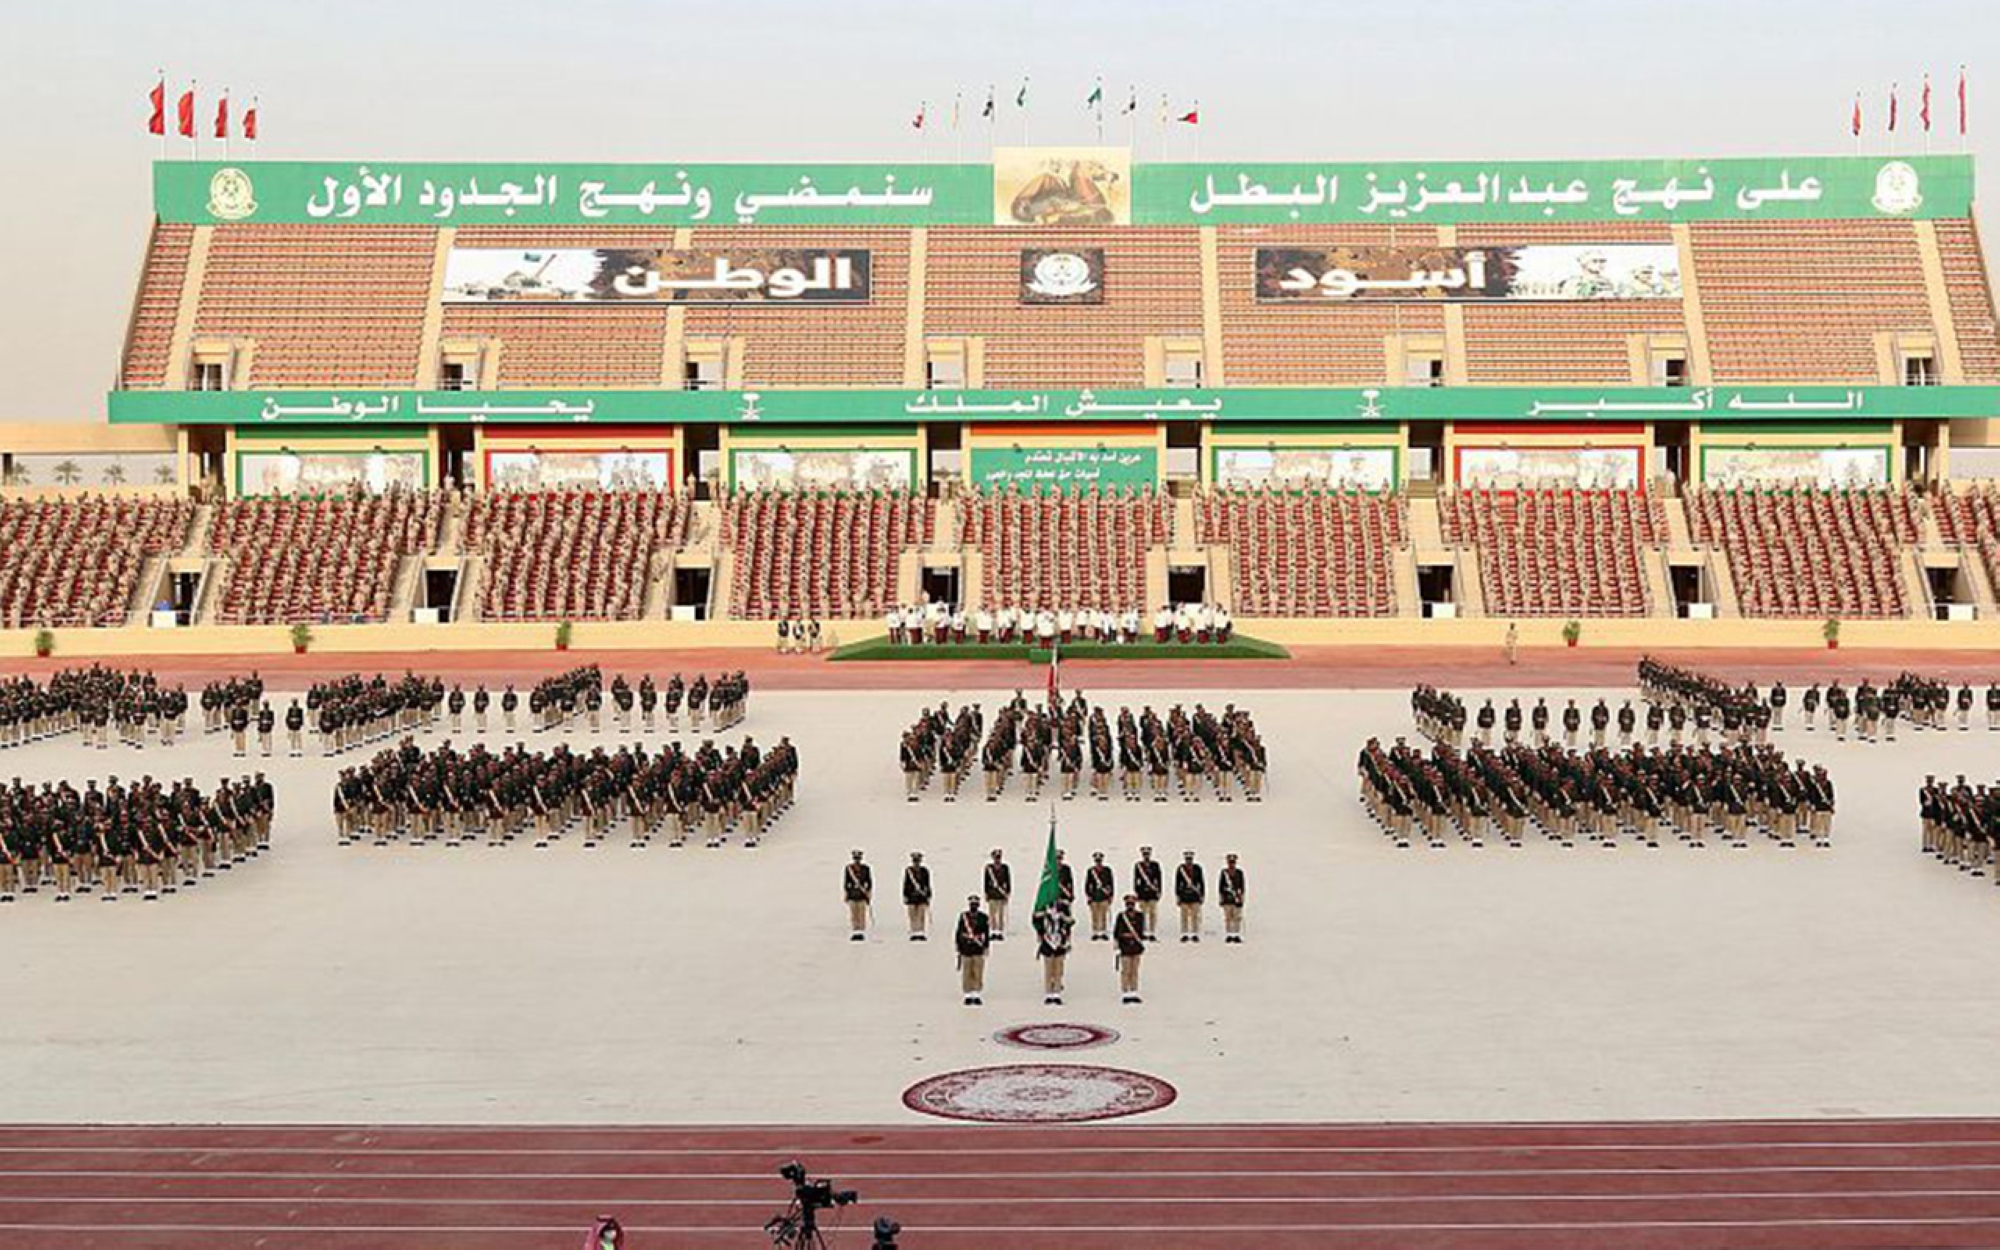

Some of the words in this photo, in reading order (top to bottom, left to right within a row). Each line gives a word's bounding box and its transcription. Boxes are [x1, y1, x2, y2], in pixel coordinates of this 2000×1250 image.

[307, 167, 401, 216] الأول
[420, 175, 556, 217] الجدود
[580, 172, 711, 219] ونهج
[735, 175, 932, 223] سنمضي
[1191, 174, 1338, 218] البطل
[1613, 167, 1713, 214] نهج
[1737, 171, 1822, 209] على
[614, 258, 850, 296] الوطن
[1280, 252, 1485, 296] أسود
[262, 396, 398, 420] الوطن
[418, 397, 593, 421] يحيا
[904, 394, 1049, 414] الملك
[1066, 389, 1221, 418] يعيش
[1527, 388, 1714, 417] أكبر
